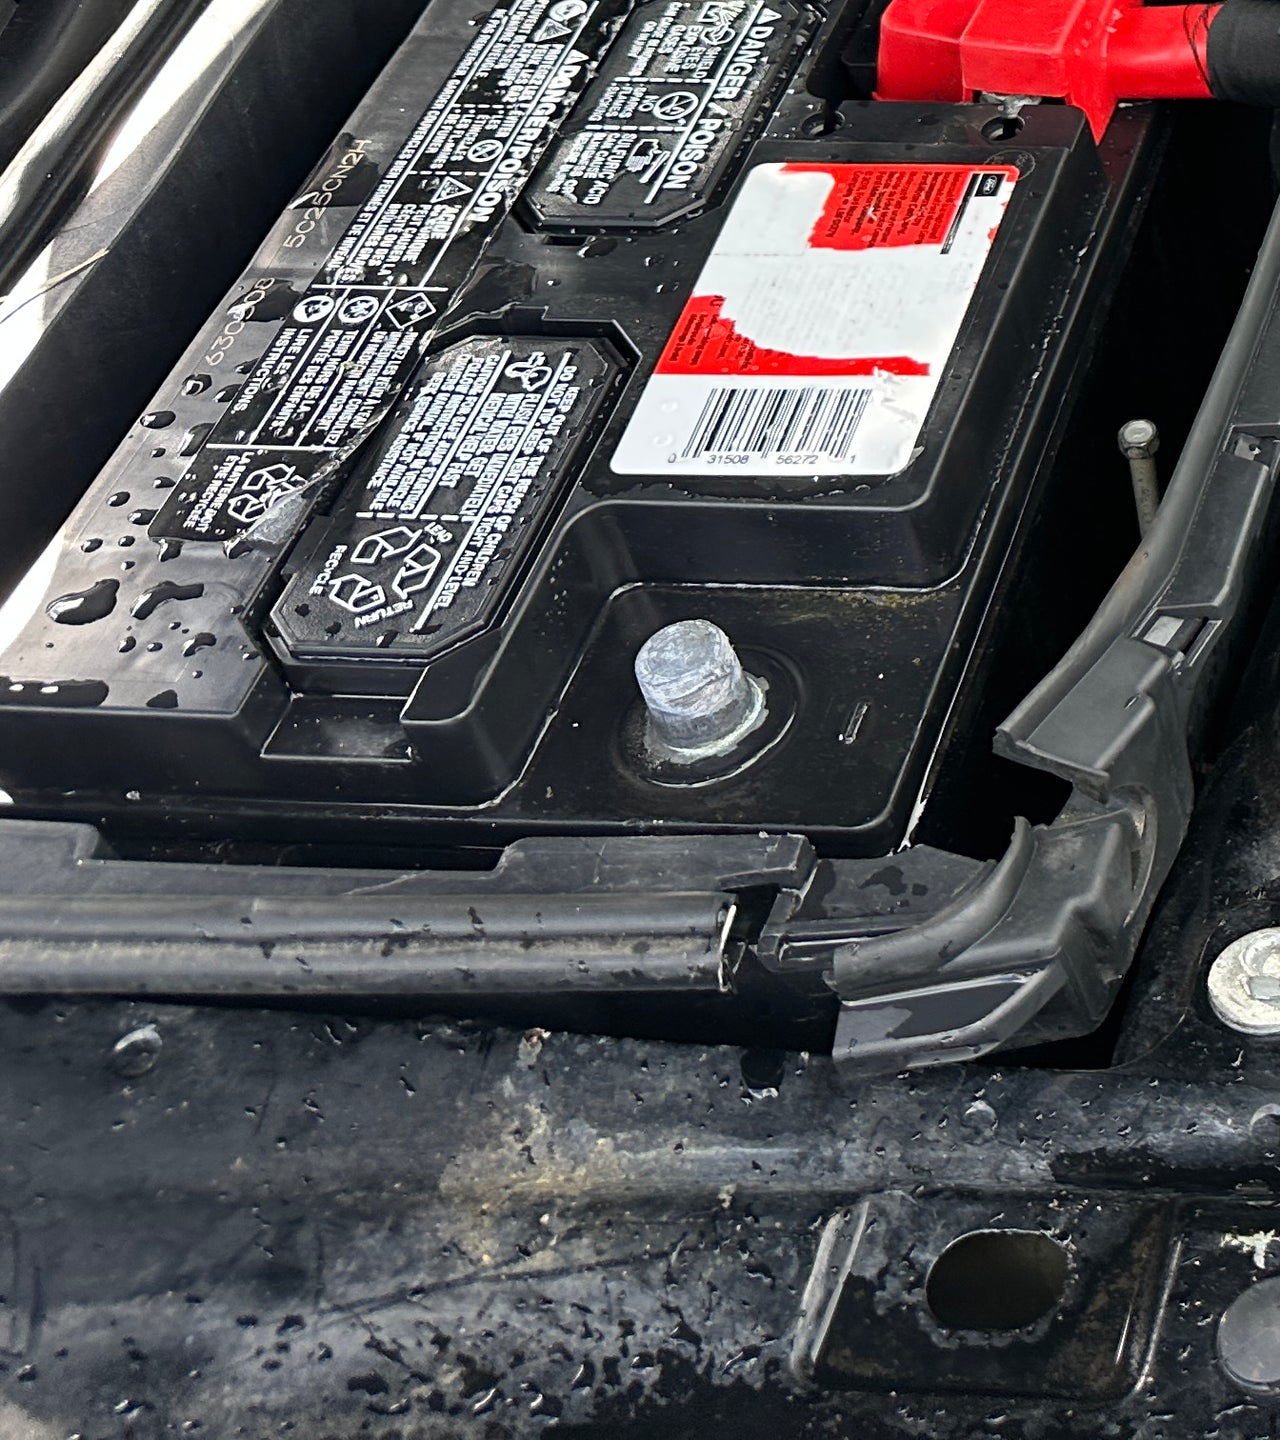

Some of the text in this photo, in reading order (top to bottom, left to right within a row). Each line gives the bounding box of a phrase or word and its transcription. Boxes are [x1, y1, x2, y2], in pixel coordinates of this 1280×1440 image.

[656, 24, 687, 53] GASES
[662, 24, 704, 72] EXPLOSIVE
[680, 46, 706, 69] EYES
[692, 46, 722, 78] SHIELD
[711, 25, 775, 99] DANGER
[429, 78, 463, 109] GARDER
[604, 86, 633, 117] FLAMES
[617, 86, 646, 118] SPARKS
[635, 94, 660, 112] NO
[423, 113, 462, 154] DE FUMER
[453, 113, 476, 129] LES
[482, 114, 505, 130] LES
[582, 132, 619, 178] CAN CAUSE
[661, 118, 723, 189] POISON
[581, 133, 637, 204] SULFURIC ACID
[278, 138, 376, 248] 5C25CN2H
[346, 224, 366, 235] DE
[355, 212, 374, 223] ET
[365, 203, 420, 266] CÉCITÉ OU DES
[375, 203, 433, 275] PEUT CAUSER LA
[285, 327, 314, 353] LIRE
[309, 329, 346, 363] PORTÉE
[228, 327, 298, 414] INSTRUCTIONS.
[294, 329, 360, 413] TENIR HORS DE LA
[296, 364, 322, 384] DES
[380, 360, 402, 375] LES
[451, 357, 486, 394] FOLLOW
[556, 365, 579, 381] DO
[455, 396, 478, 414] FOR
[494, 392, 526, 418] WITH
[544, 382, 570, 404] NOT
[321, 398, 363, 444] CONSULTEZ
[509, 393, 543, 425] FLUSH
[409, 431, 427, 441] IF
[435, 392, 508, 487] MEDICAL HELP FAST
[440, 415, 467, 439] SAFE
[494, 425, 525, 452] EYES
[517, 427, 546, 454] KEEP
[236, 451, 256, 464] LA
[396, 442, 421, 462] NOT
[424, 439, 453, 466] JUMP
[667, 453, 677, 464] 0
[706, 454, 750, 465] 31508
[775, 454, 819, 465] 56272
[460, 456, 490, 478] GET
[501, 456, 530, 484] VENT
[384, 470, 421, 507] VEHICLE
[398, 466, 437, 510] STARTING
[459, 385, 582, 587] KEEP OUT OF THE REACH OF CHILDREN
[485, 485, 514, 513] CAPS
[466, 516, 497, 547] TIGHT
[306, 544, 349, 594] RECYCLE
[354, 599, 412, 628] RETURN
